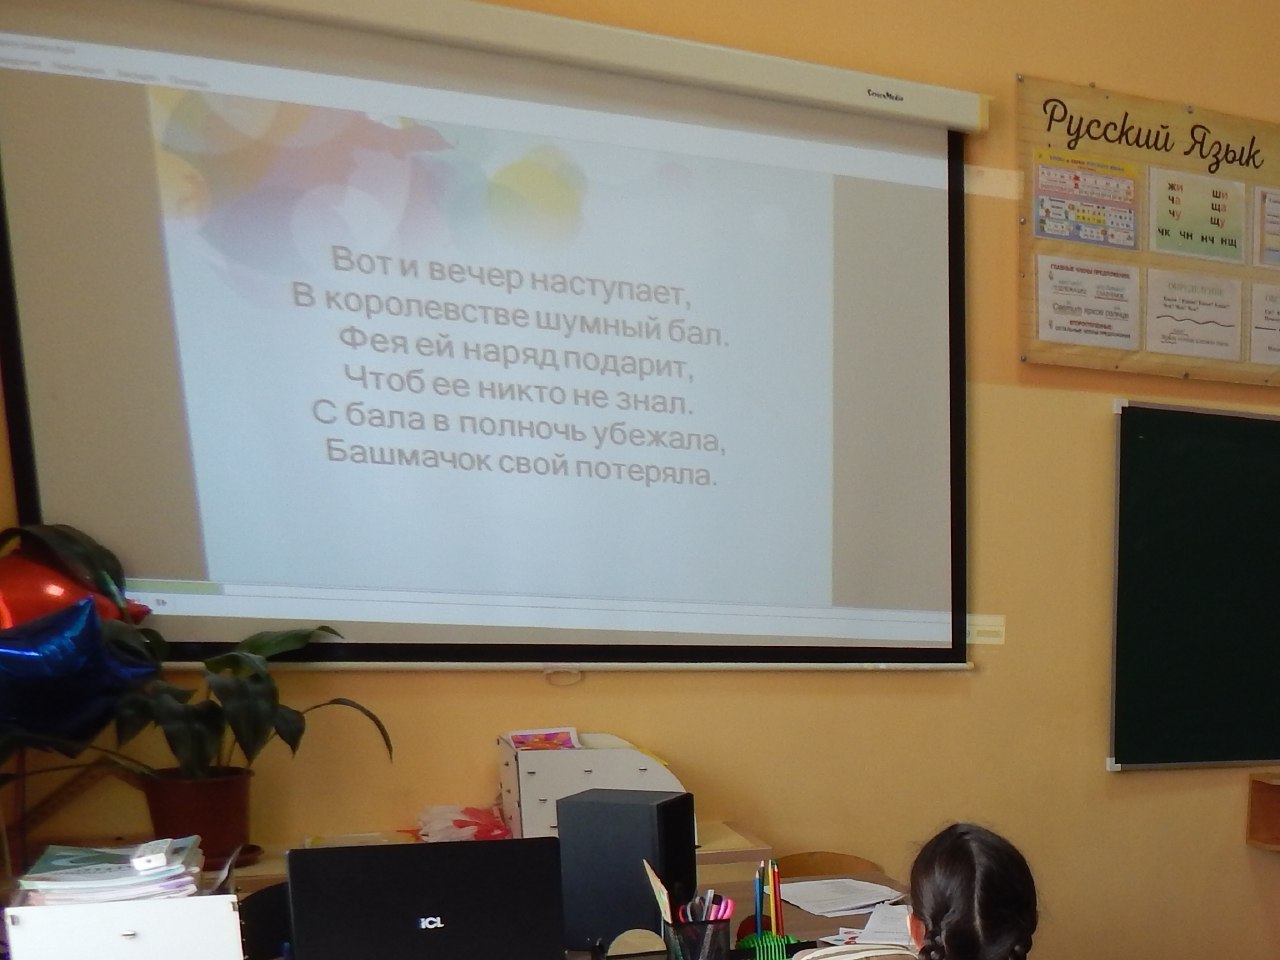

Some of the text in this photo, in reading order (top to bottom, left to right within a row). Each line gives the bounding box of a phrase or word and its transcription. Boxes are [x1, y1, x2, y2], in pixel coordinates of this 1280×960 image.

[1042, 98, 1265, 174] Русский Язык
[1168, 182, 1183, 192] жи
[1168, 195, 1181, 205] ча
[1212, 189, 1229, 200] ши
[1168, 209, 1182, 221] чу
[1210, 216, 1226, 229] щу
[1211, 203, 1227, 213] ща
[1158, 227, 1237, 248] чк чн нч нщ
[332, 245, 691, 311] Вот и вечер наступает,
[292, 281, 729, 348] В королевстве шумный бал.
[339, 325, 694, 383] Фея ей наряд подарит,
[344, 364, 693, 415] Чтоб ее никто не знал.
[312, 399, 726, 456] С бала в полночь убежала,
[326, 438, 717, 488] Башмачок свой потеряла.
